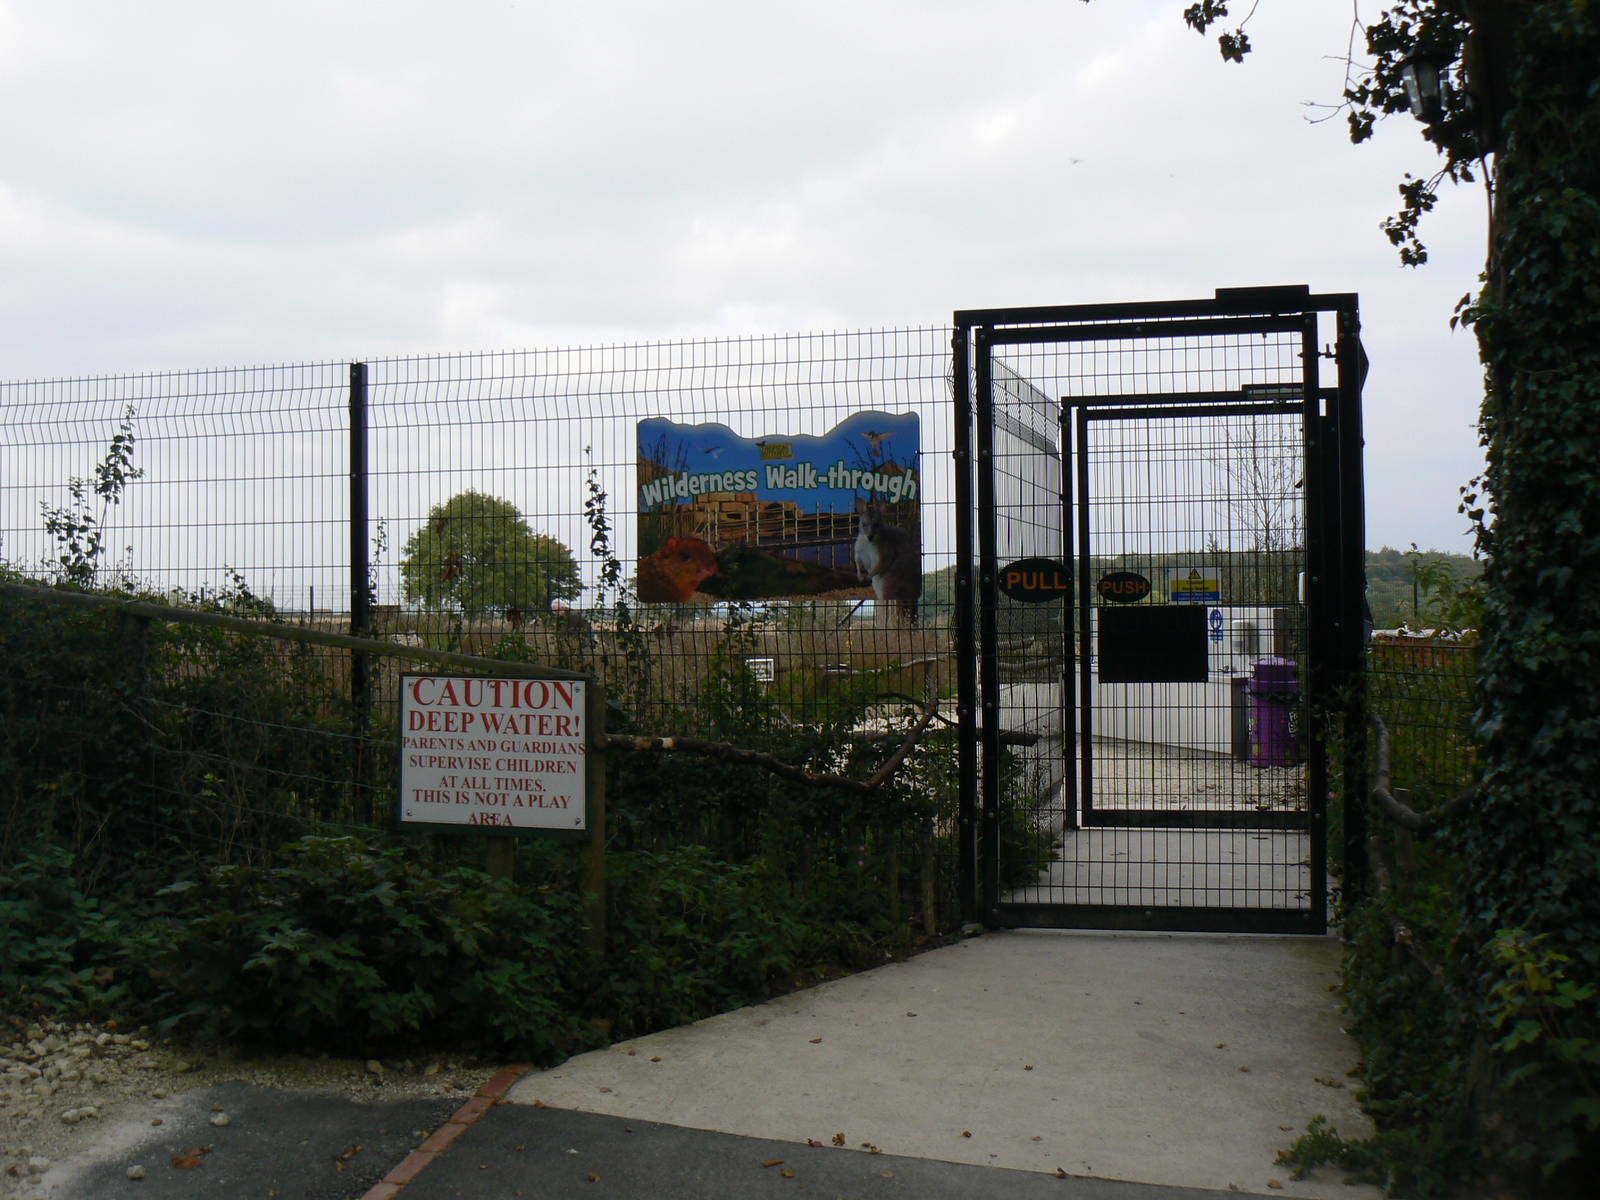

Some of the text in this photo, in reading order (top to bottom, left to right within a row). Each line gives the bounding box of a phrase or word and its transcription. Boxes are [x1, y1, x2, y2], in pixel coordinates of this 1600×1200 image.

[641, 459, 918, 507] Wilderness Walk-through
[1007, 571, 1067, 590] PULL
[1102, 580, 1146, 594] PUSH
[413, 677, 575, 710] CAUTION
[408, 710, 580, 737] DEEP WATER!
[403, 736, 587, 755] PARENTS AND GUARDIANS
[409, 755, 577, 774] SUPERVISE CHILDREN
[439, 776, 547, 792] AT ALL TIMES.
[412, 789, 571, 809] THIS IS NOT A PLAY
[468, 812, 513, 826] AREA
